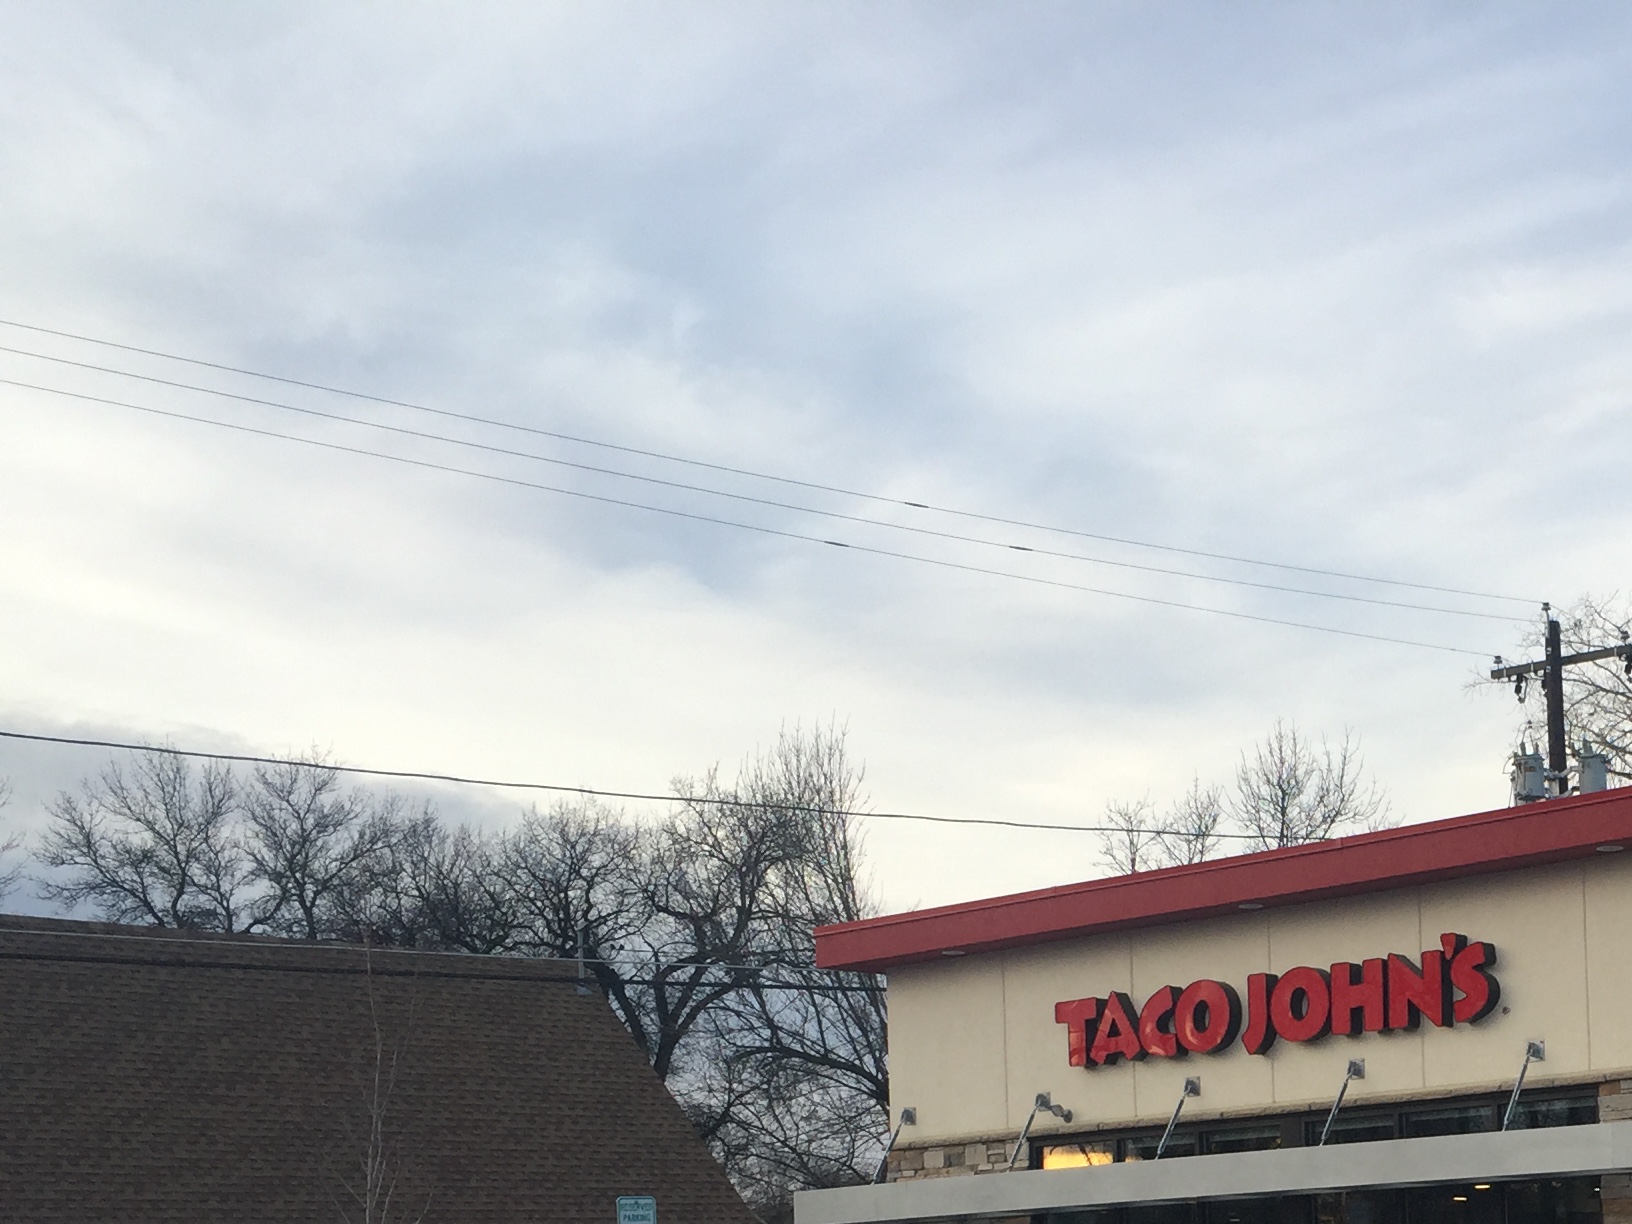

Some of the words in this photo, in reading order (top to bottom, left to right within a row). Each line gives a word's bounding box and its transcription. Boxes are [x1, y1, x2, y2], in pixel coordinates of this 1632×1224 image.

[1055, 979, 1242, 1068] TACO
[1242, 932, 1500, 1055] JOHN'S
[623, 1214, 651, 1222] PARKING
